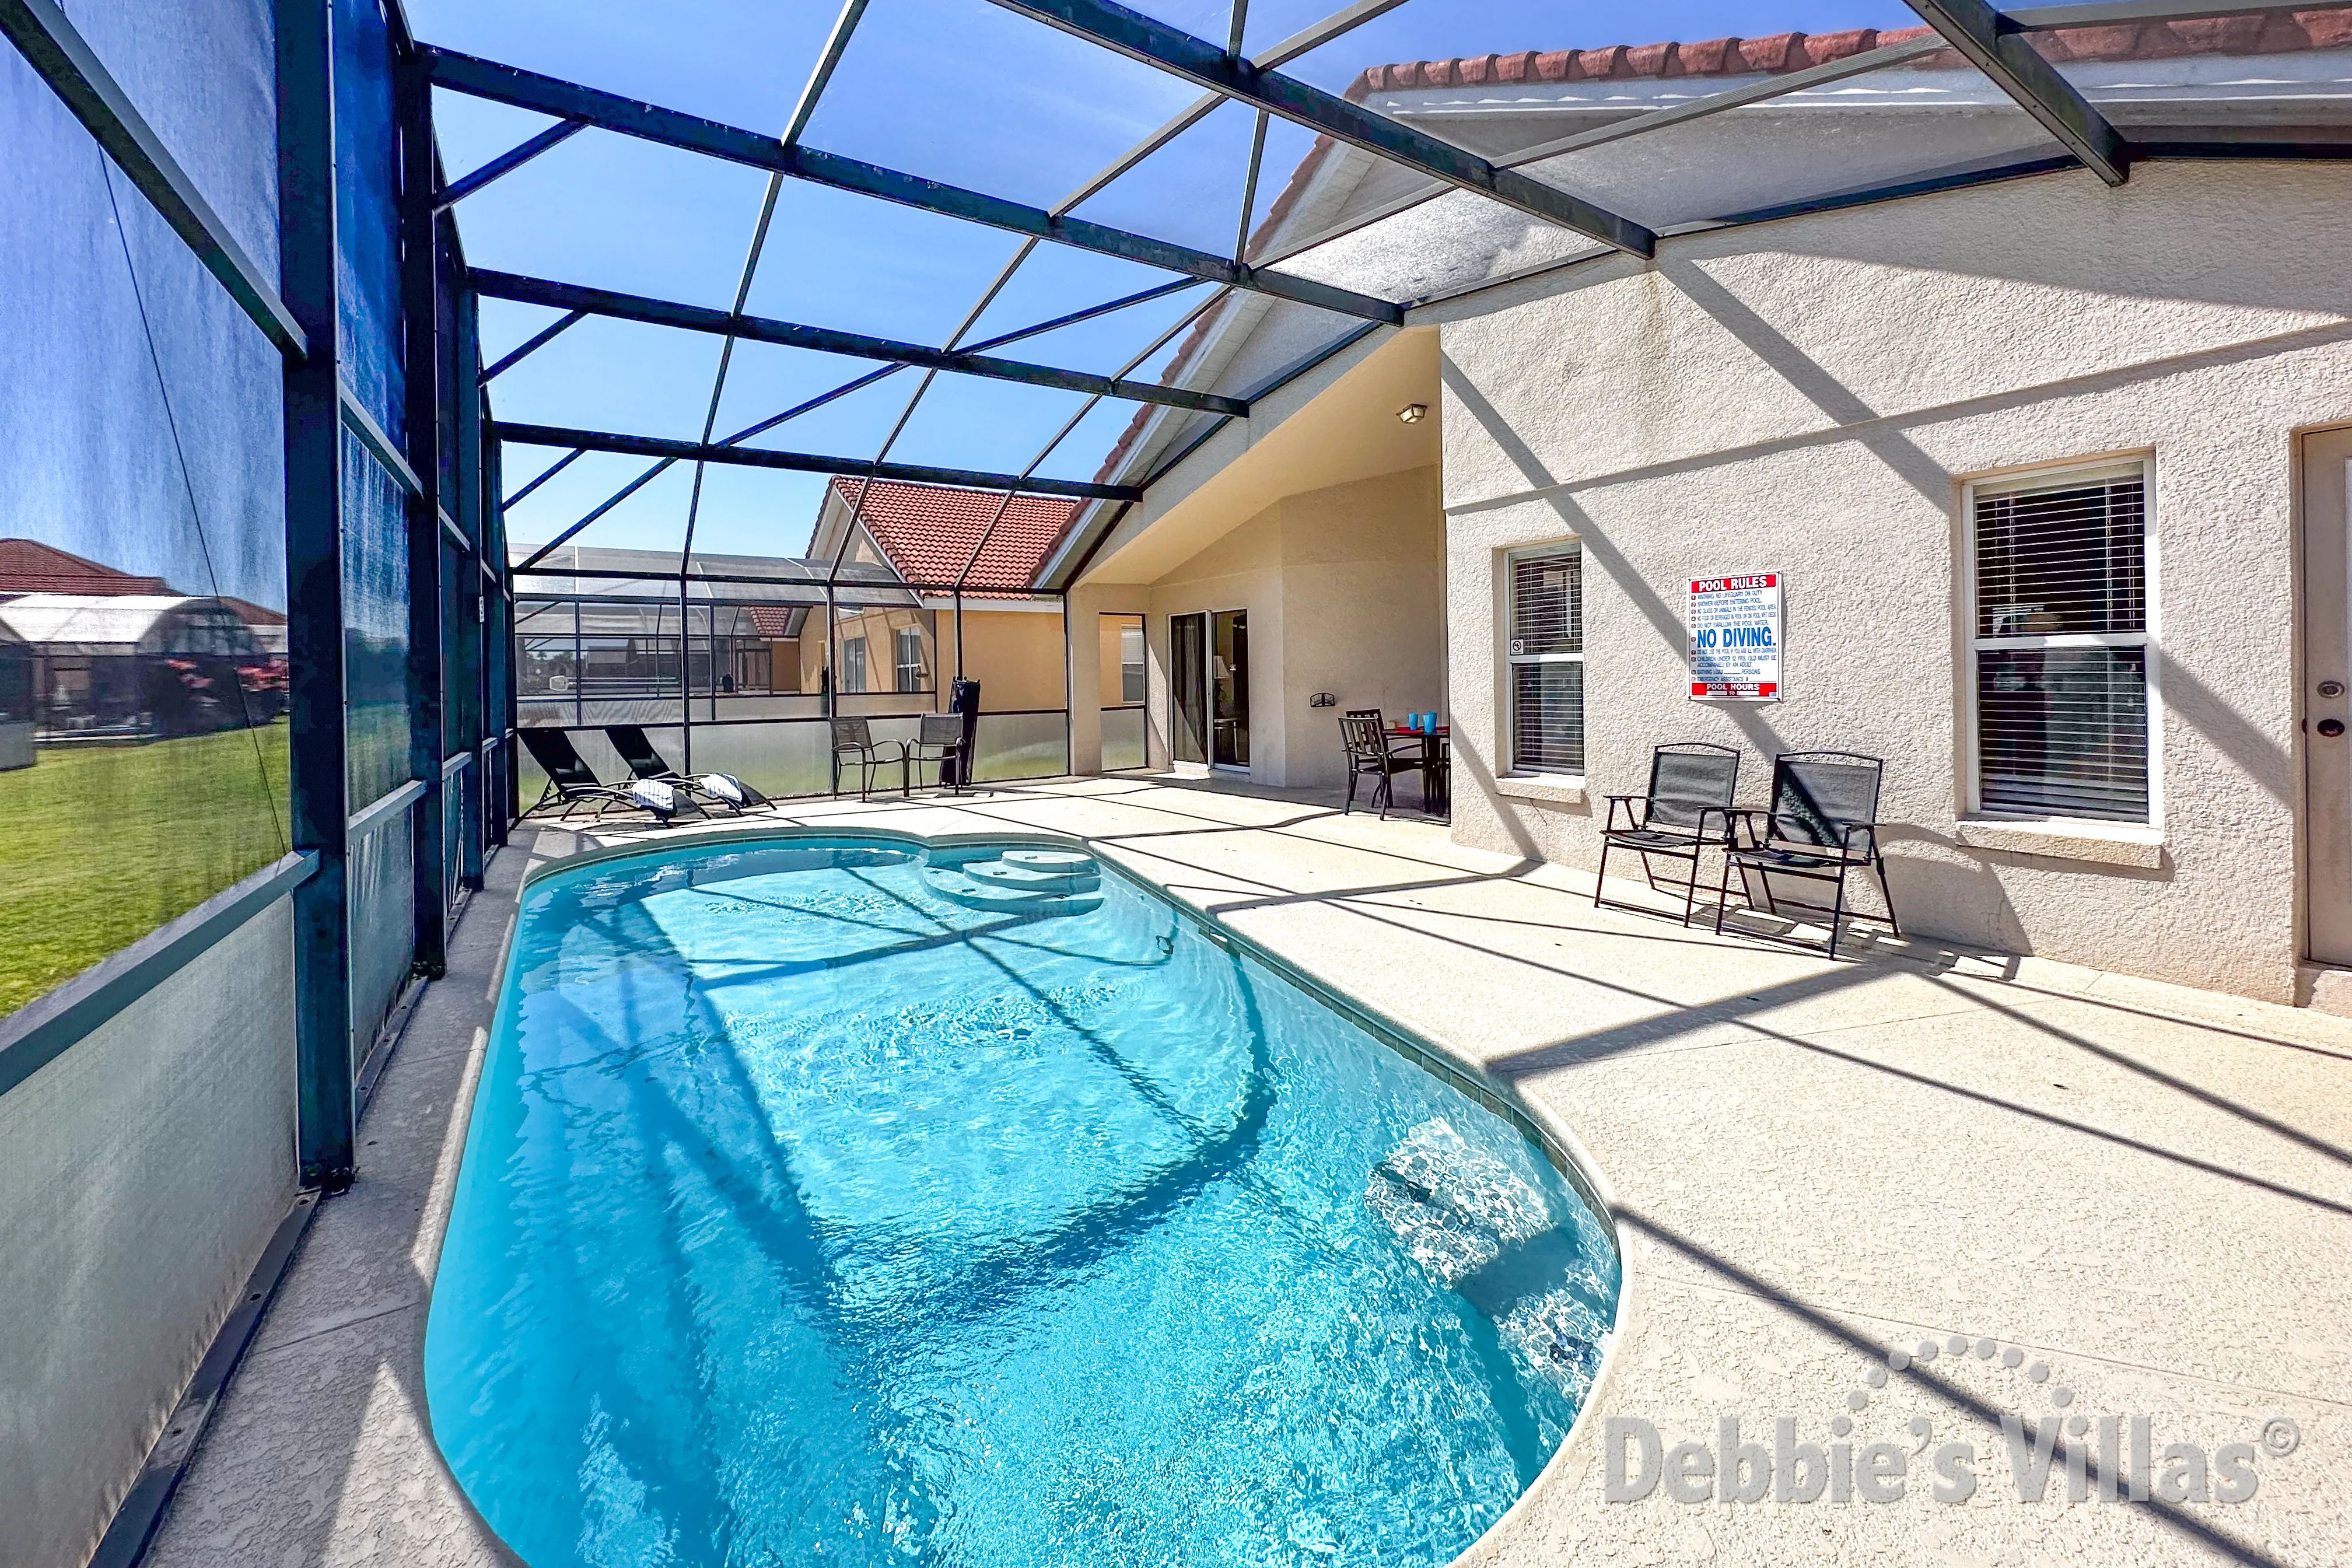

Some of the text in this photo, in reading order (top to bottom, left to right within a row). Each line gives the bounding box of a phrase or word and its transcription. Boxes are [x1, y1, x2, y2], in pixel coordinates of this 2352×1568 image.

[1699, 576, 1767, 592] POOL RULES
[1697, 629, 1717, 648] NO
[1723, 626, 1776, 647] DIVING.
